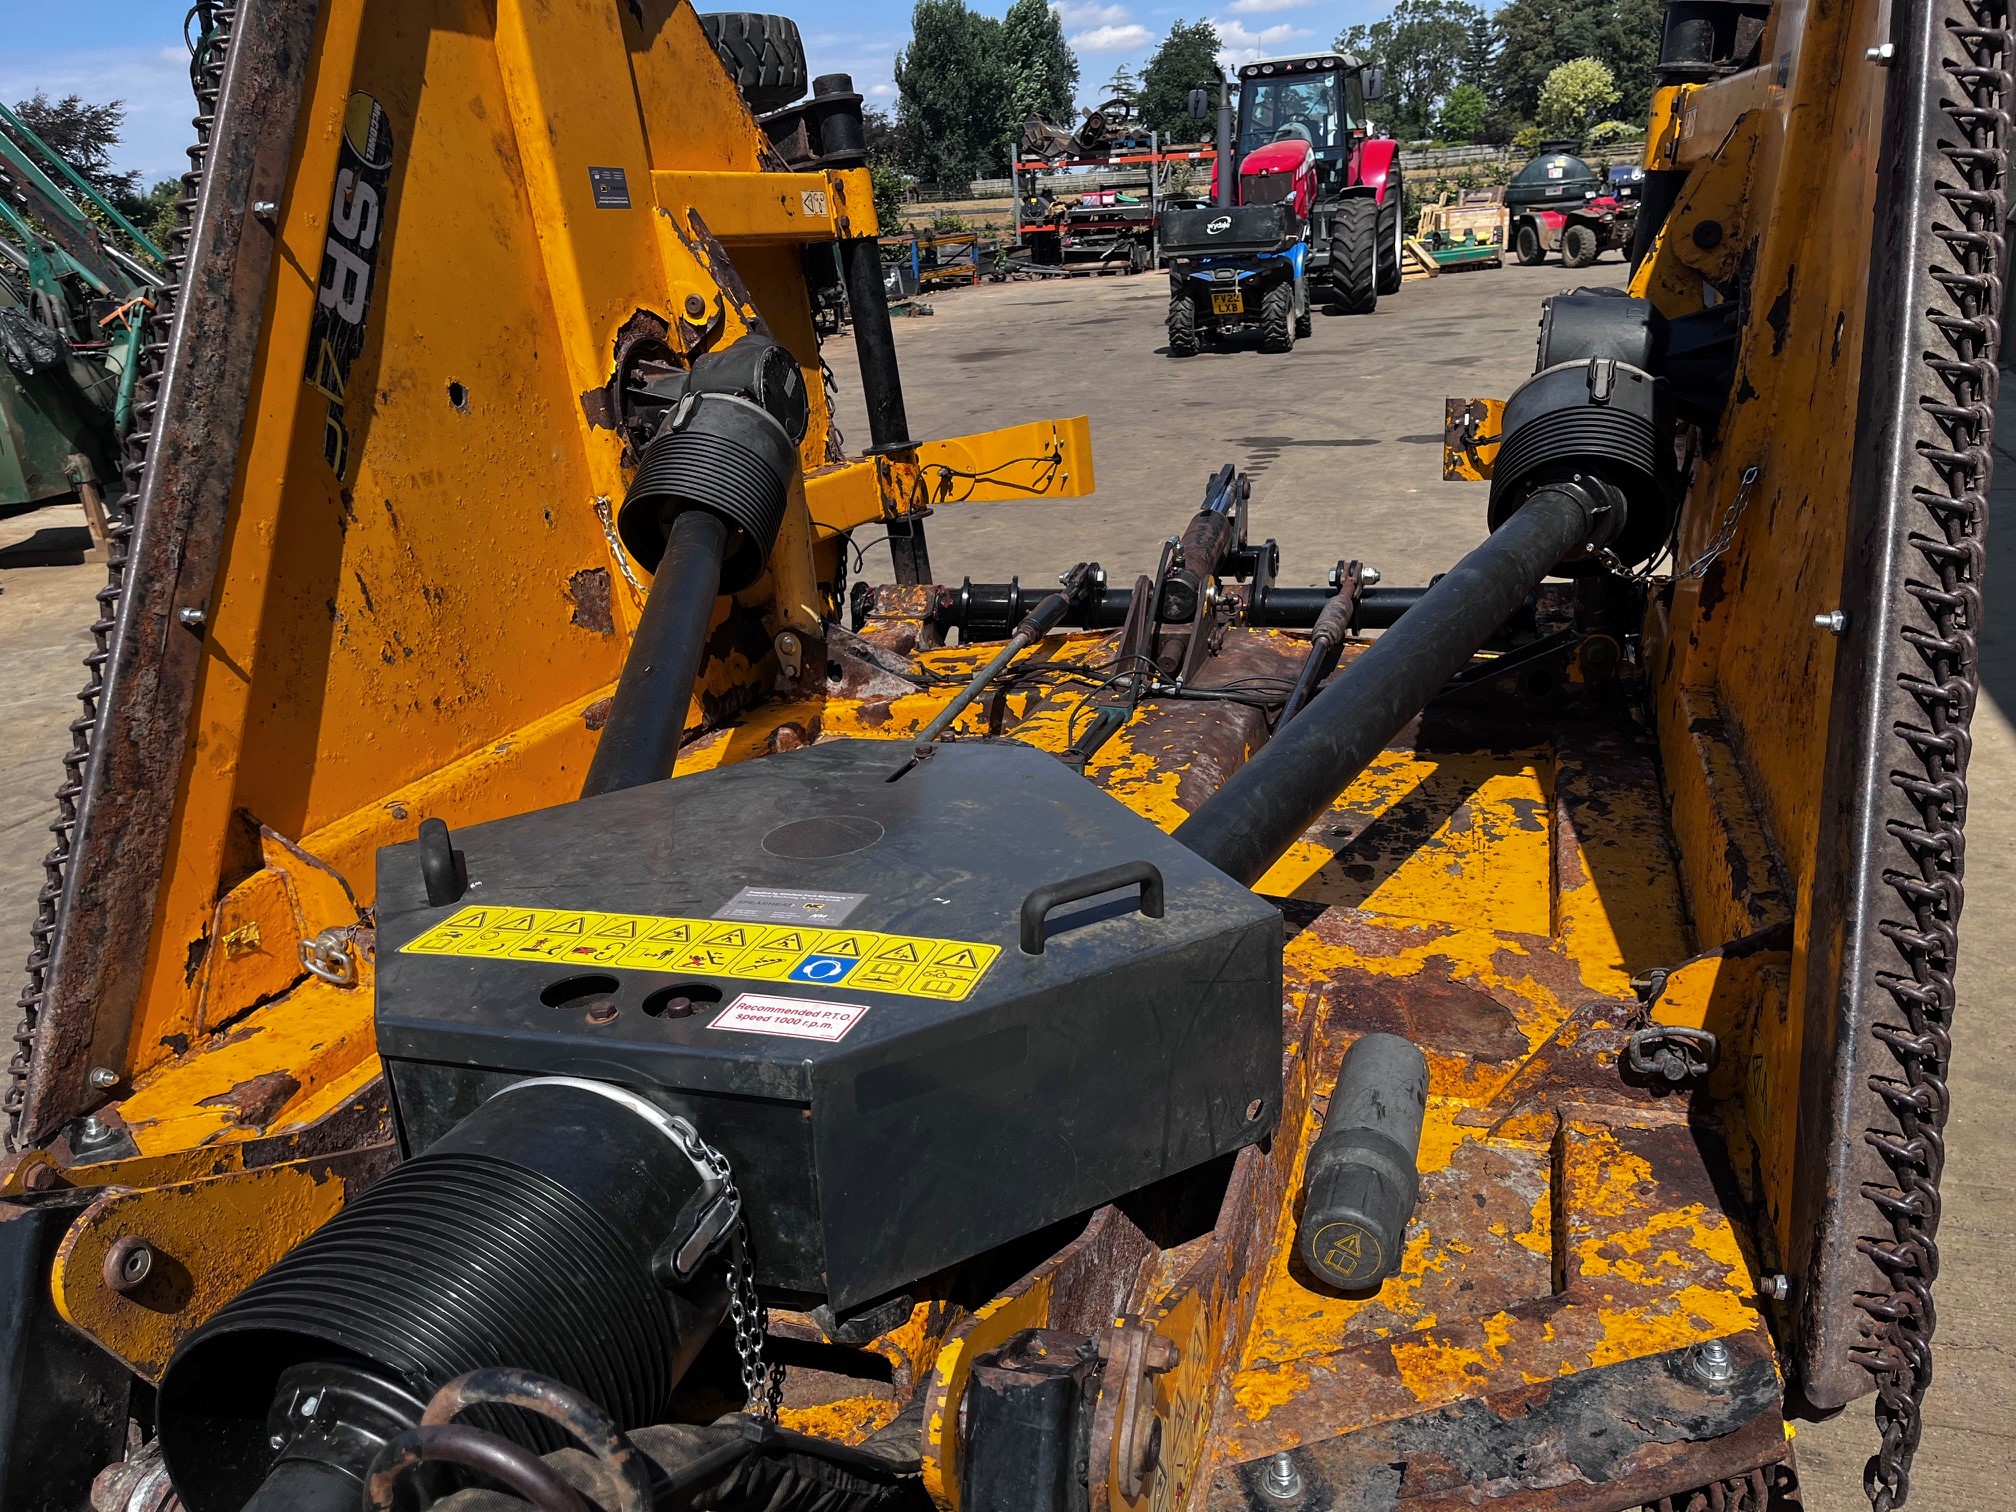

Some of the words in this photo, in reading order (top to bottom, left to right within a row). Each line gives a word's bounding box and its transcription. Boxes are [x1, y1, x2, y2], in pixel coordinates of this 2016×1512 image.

[1207, 221, 1231, 230] wydale
[318, 167, 379, 325] SR
[1218, 304, 1238, 312] LXB
[736, 1003, 821, 1017] Recommended
[822, 1011, 851, 1022] P.T.O.
[735, 1013, 772, 1022] speed
[774, 1016, 802, 1026] 1000
[802, 1020, 833, 1029] r.p.m.
